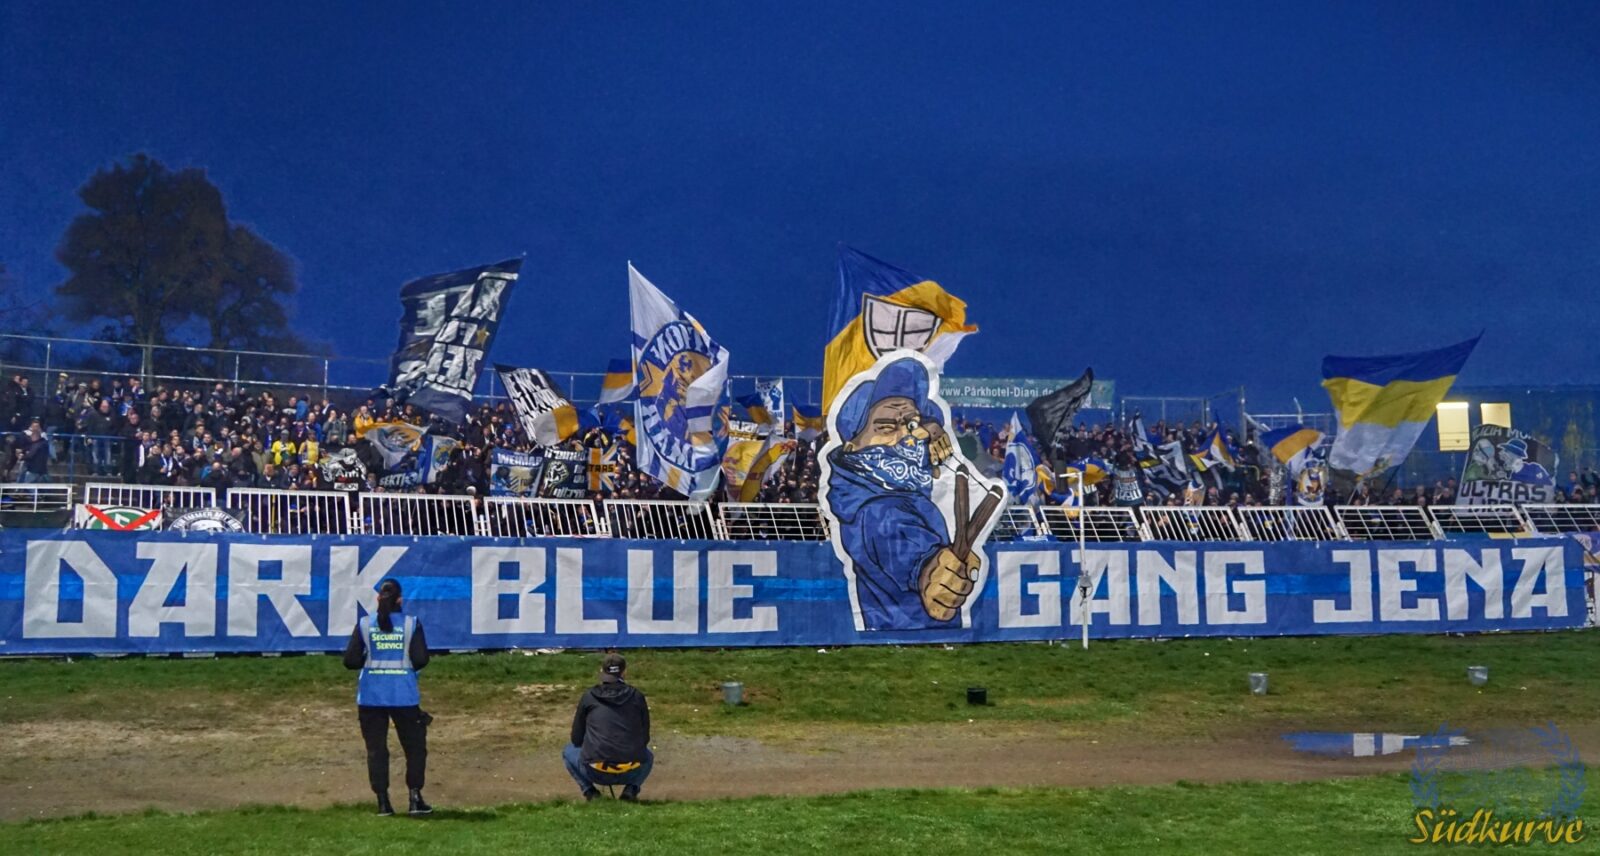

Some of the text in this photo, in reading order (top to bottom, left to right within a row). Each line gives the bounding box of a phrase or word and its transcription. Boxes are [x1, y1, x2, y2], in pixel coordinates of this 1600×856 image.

[1460, 481, 1546, 503] ULTRAS
[23, 540, 1568, 640] DARK BLUE GANG JENA
[371, 633, 404, 641] SECURITY
[376, 642, 404, 650] SERVICE
